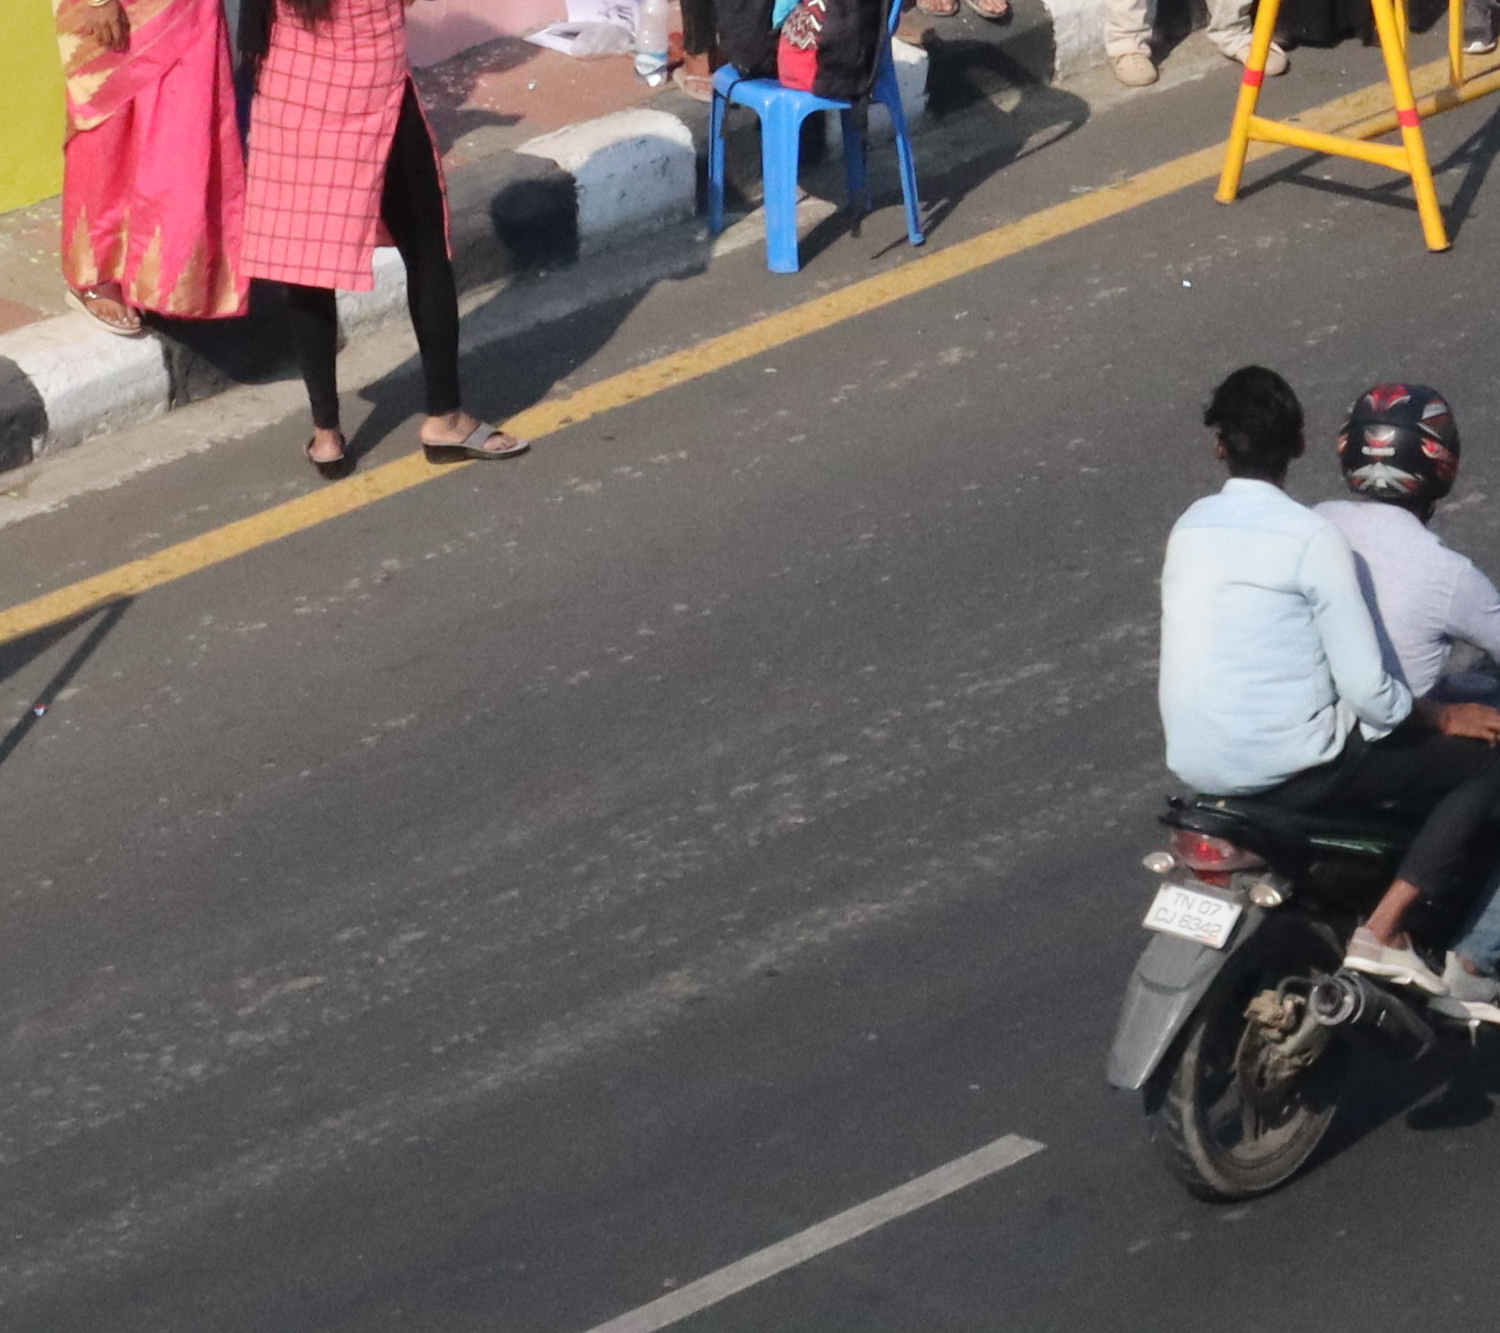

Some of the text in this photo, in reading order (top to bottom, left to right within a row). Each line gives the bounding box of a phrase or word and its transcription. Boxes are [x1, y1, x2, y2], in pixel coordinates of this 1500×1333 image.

[1174, 892, 1222, 916] TN 07
[1155, 907, 1222, 936] CJ 6342
